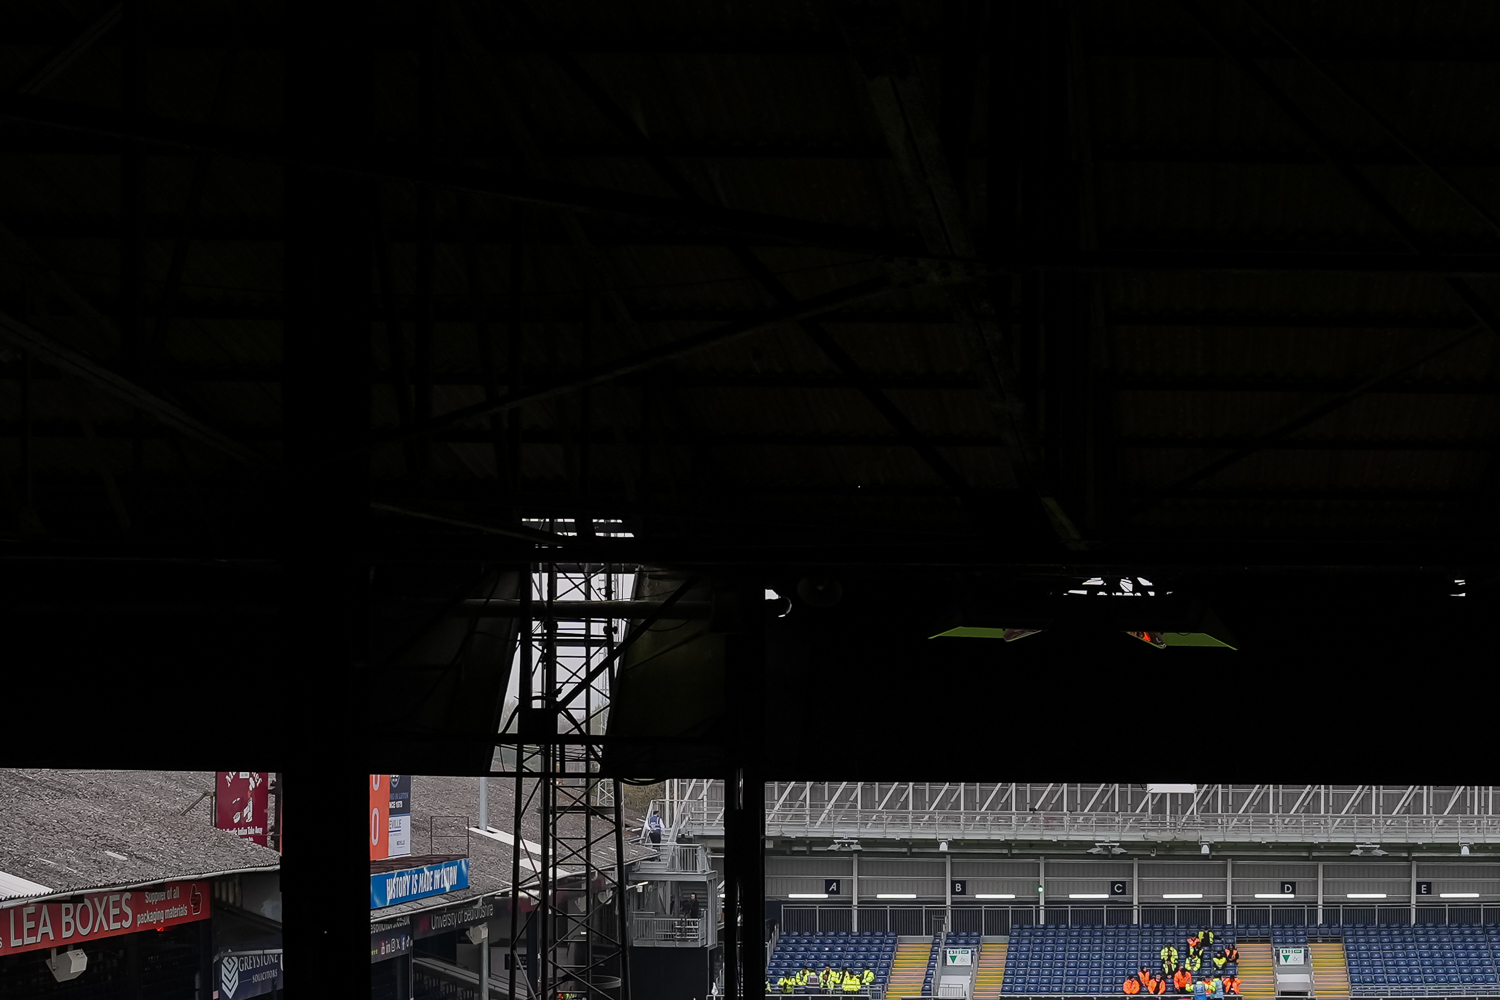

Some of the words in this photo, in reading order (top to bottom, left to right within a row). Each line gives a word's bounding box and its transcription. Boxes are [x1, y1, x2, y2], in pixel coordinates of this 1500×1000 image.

[372, 808, 379, 846] 0
[386, 874, 410, 900] HISTORY
[411, 874, 418, 894] IS
[418, 871, 432, 893] MADE
[434, 871, 440, 890] IN
[440, 866, 458, 888] LUTON
[829, 882, 836, 891] A
[956, 884, 961, 892] B
[1114, 884, 1122, 892] C
[1285, 884, 1292, 893] D
[1421, 885, 1427, 893] E
[167, 886, 172, 900] of
[10, 905, 54, 948] LEA
[62, 892, 132, 938] BOXES
[137, 908, 164, 927] packaging
[165, 904, 187, 919] materials
[431, 912, 457, 930] University
[239, 954, 278, 971] GREYSTONE
[252, 969, 278, 983] SOLICITORS
